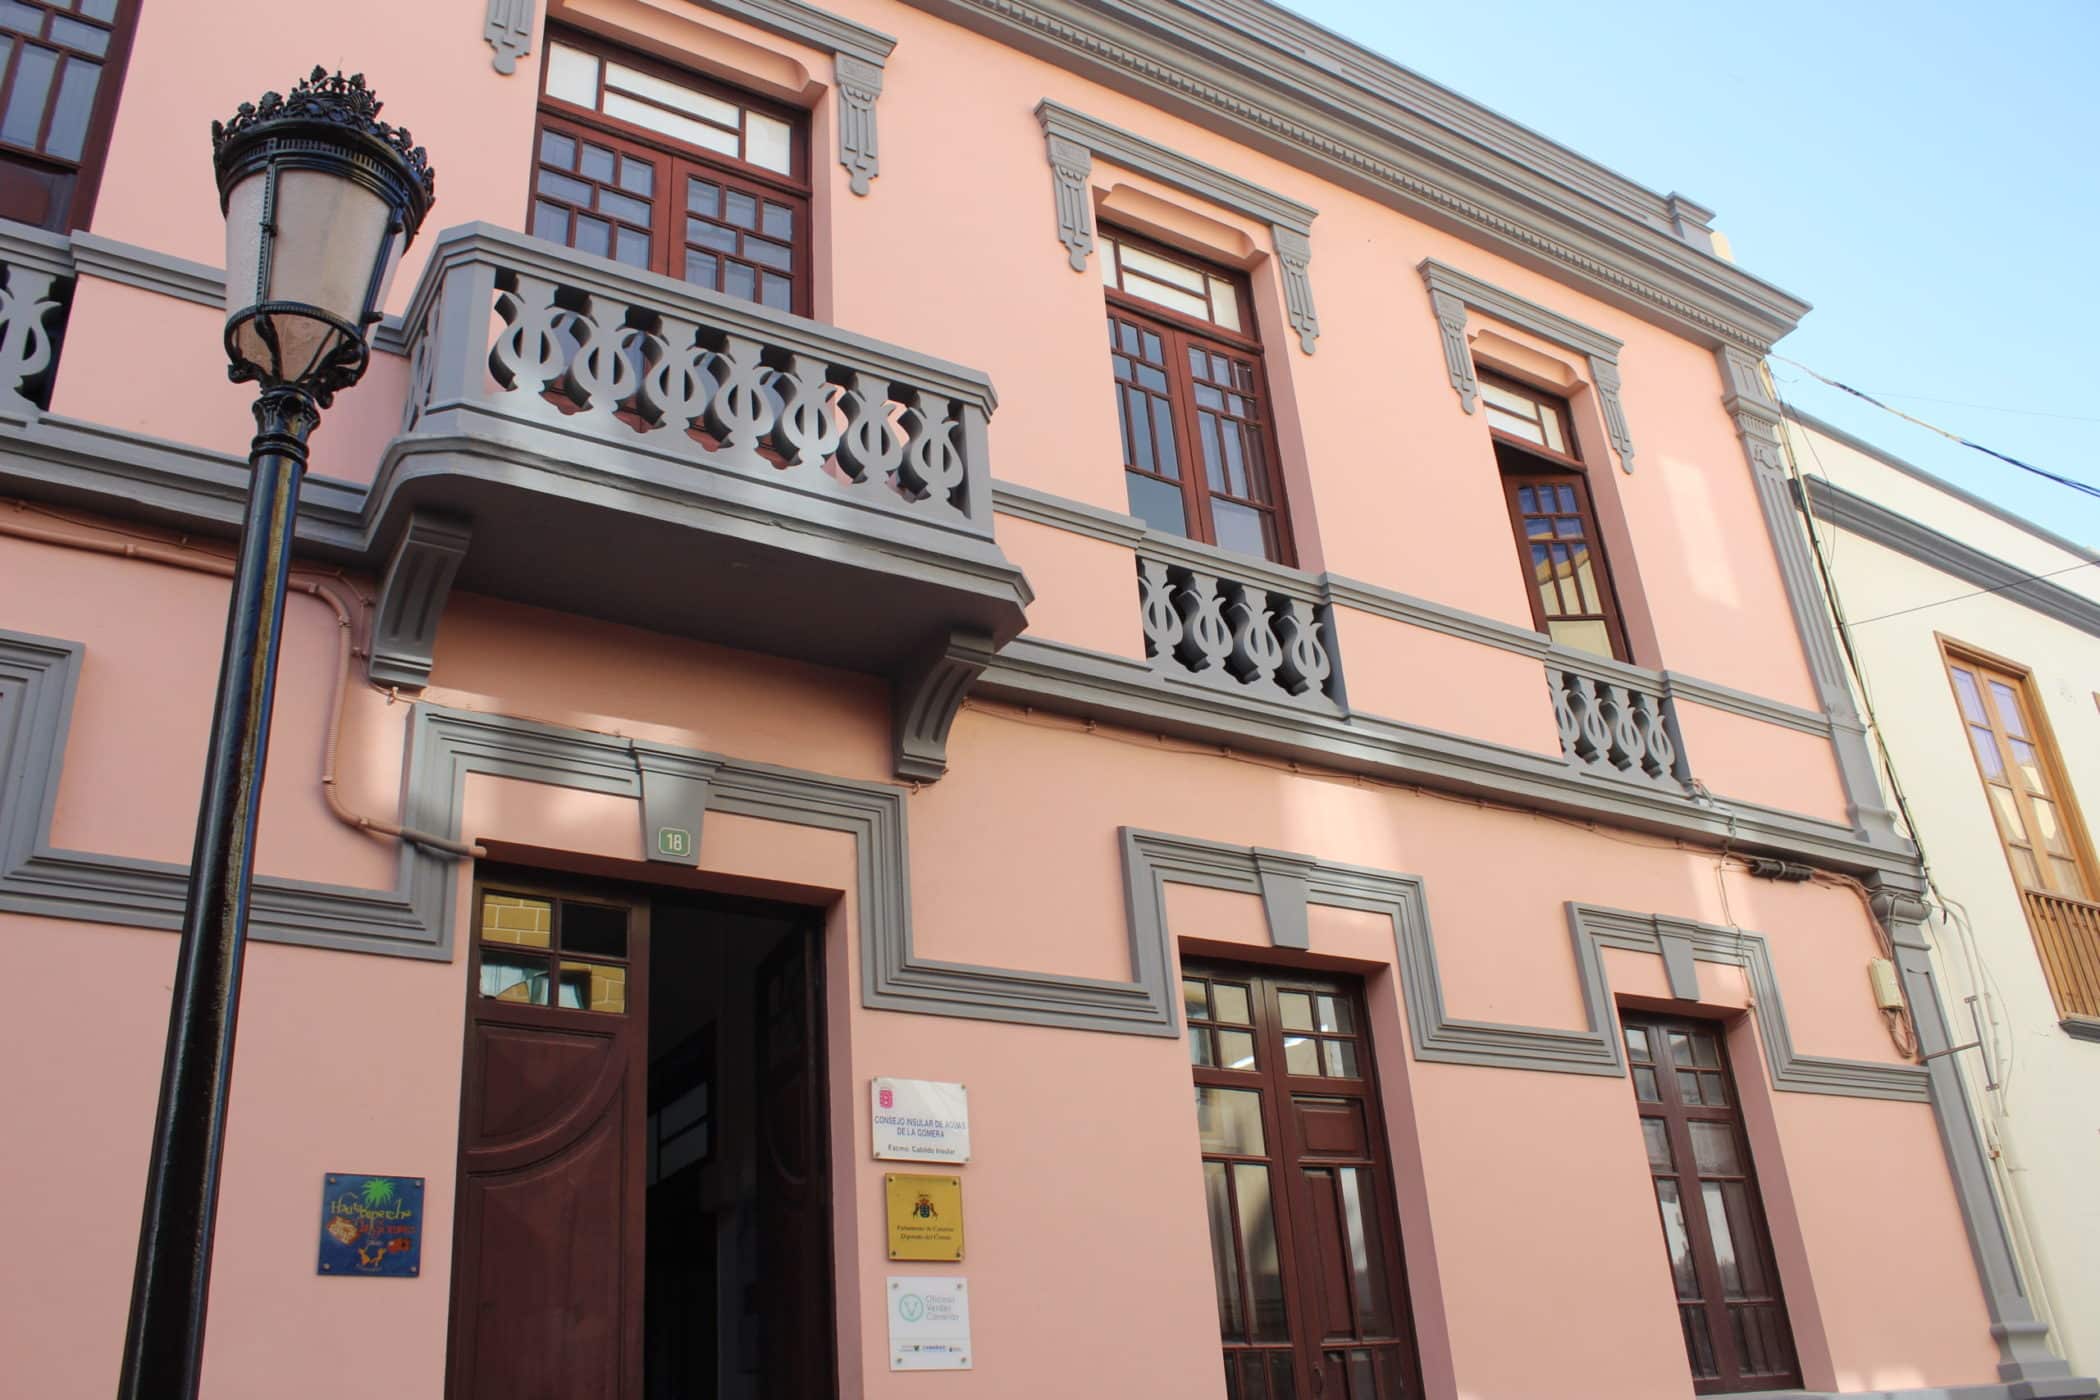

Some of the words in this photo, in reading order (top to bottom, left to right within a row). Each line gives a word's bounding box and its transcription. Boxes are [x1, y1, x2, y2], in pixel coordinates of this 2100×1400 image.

[666, 832, 682, 851] 18
[874, 1115, 905, 1126] CONSEJO
[905, 1118, 934, 1128] INSULAR
[935, 1120, 944, 1128] DE
[896, 1126, 906, 1136] DE
[907, 1127, 917, 1137] LA
[917, 1128, 945, 1138] GOMERA
